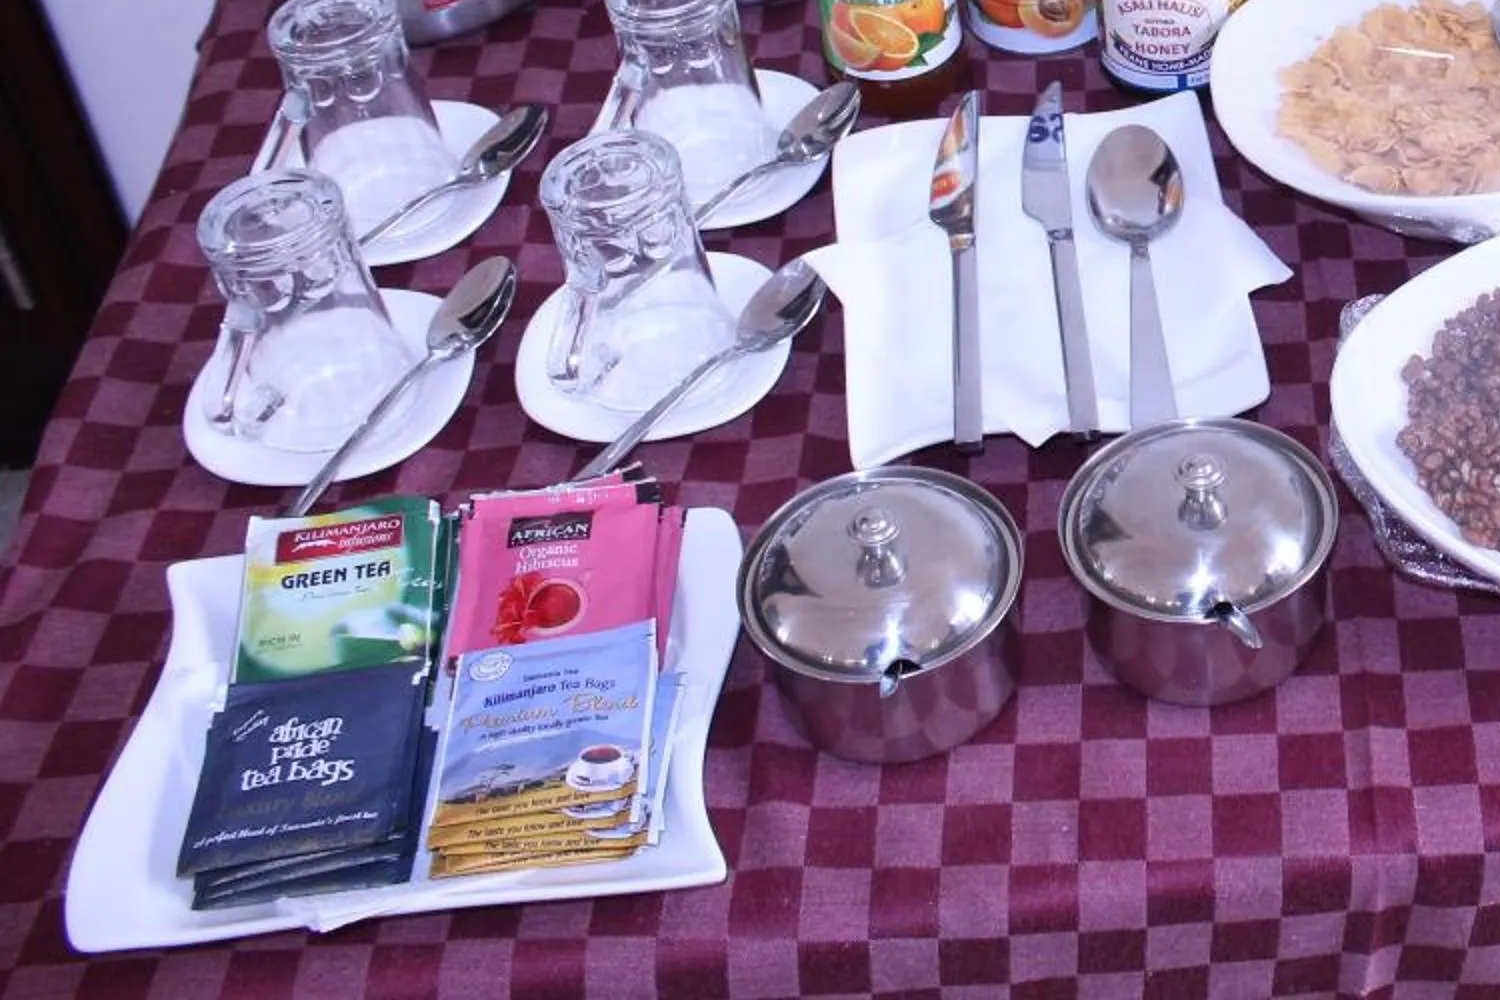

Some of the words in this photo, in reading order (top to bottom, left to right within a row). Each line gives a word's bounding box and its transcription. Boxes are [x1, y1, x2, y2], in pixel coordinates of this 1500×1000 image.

[1118, 0, 1153, 16] ASALI
[1132, 24, 1192, 38] TABORA
[1135, 43, 1191, 55] HONEY
[294, 519, 400, 543] KILIMANJARO
[511, 523, 589, 541] AFRICAN
[519, 543, 578, 561] Organic
[515, 556, 579, 574] Hibiscus
[281, 567, 347, 590] GREEN
[354, 560, 391, 579] TEA
[484, 682, 556, 708] Kilimanjaro
[560, 679, 581, 692] Tea
[585, 677, 616, 693] Bags
[269, 717, 343, 743] african
[271, 738, 331, 765] pride
[241, 765, 282, 791] tea
[287, 759, 355, 786] bags
[507, 825, 523, 837] you
